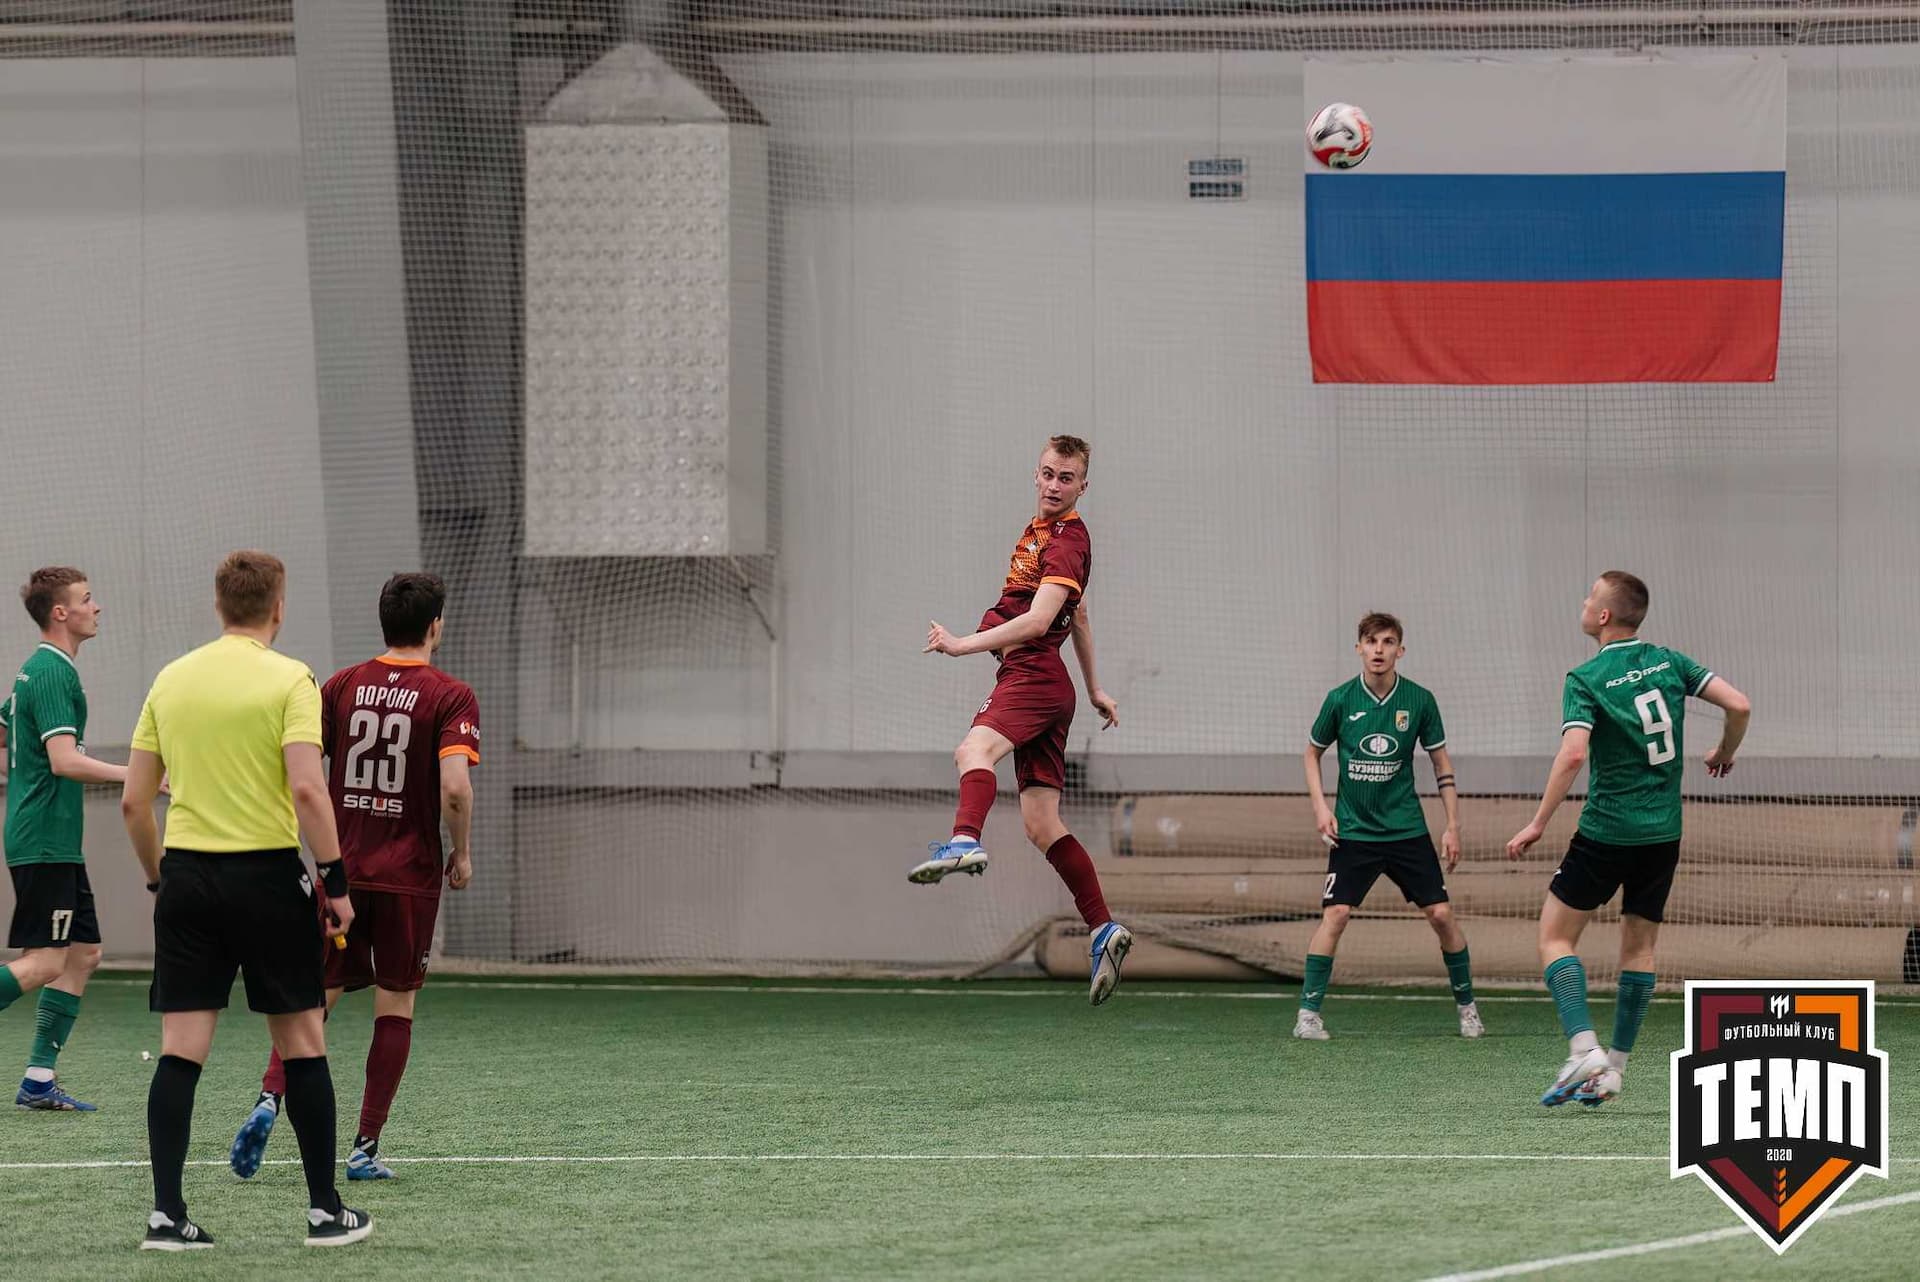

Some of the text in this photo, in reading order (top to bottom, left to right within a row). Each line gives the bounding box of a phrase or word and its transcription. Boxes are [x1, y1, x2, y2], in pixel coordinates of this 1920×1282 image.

[355, 685, 419, 712] ВОРОНА
[1634, 687, 1676, 766] 9
[344, 709, 412, 793] 23
[343, 794, 403, 813] SEUS
[51, 909, 73, 940] 17
